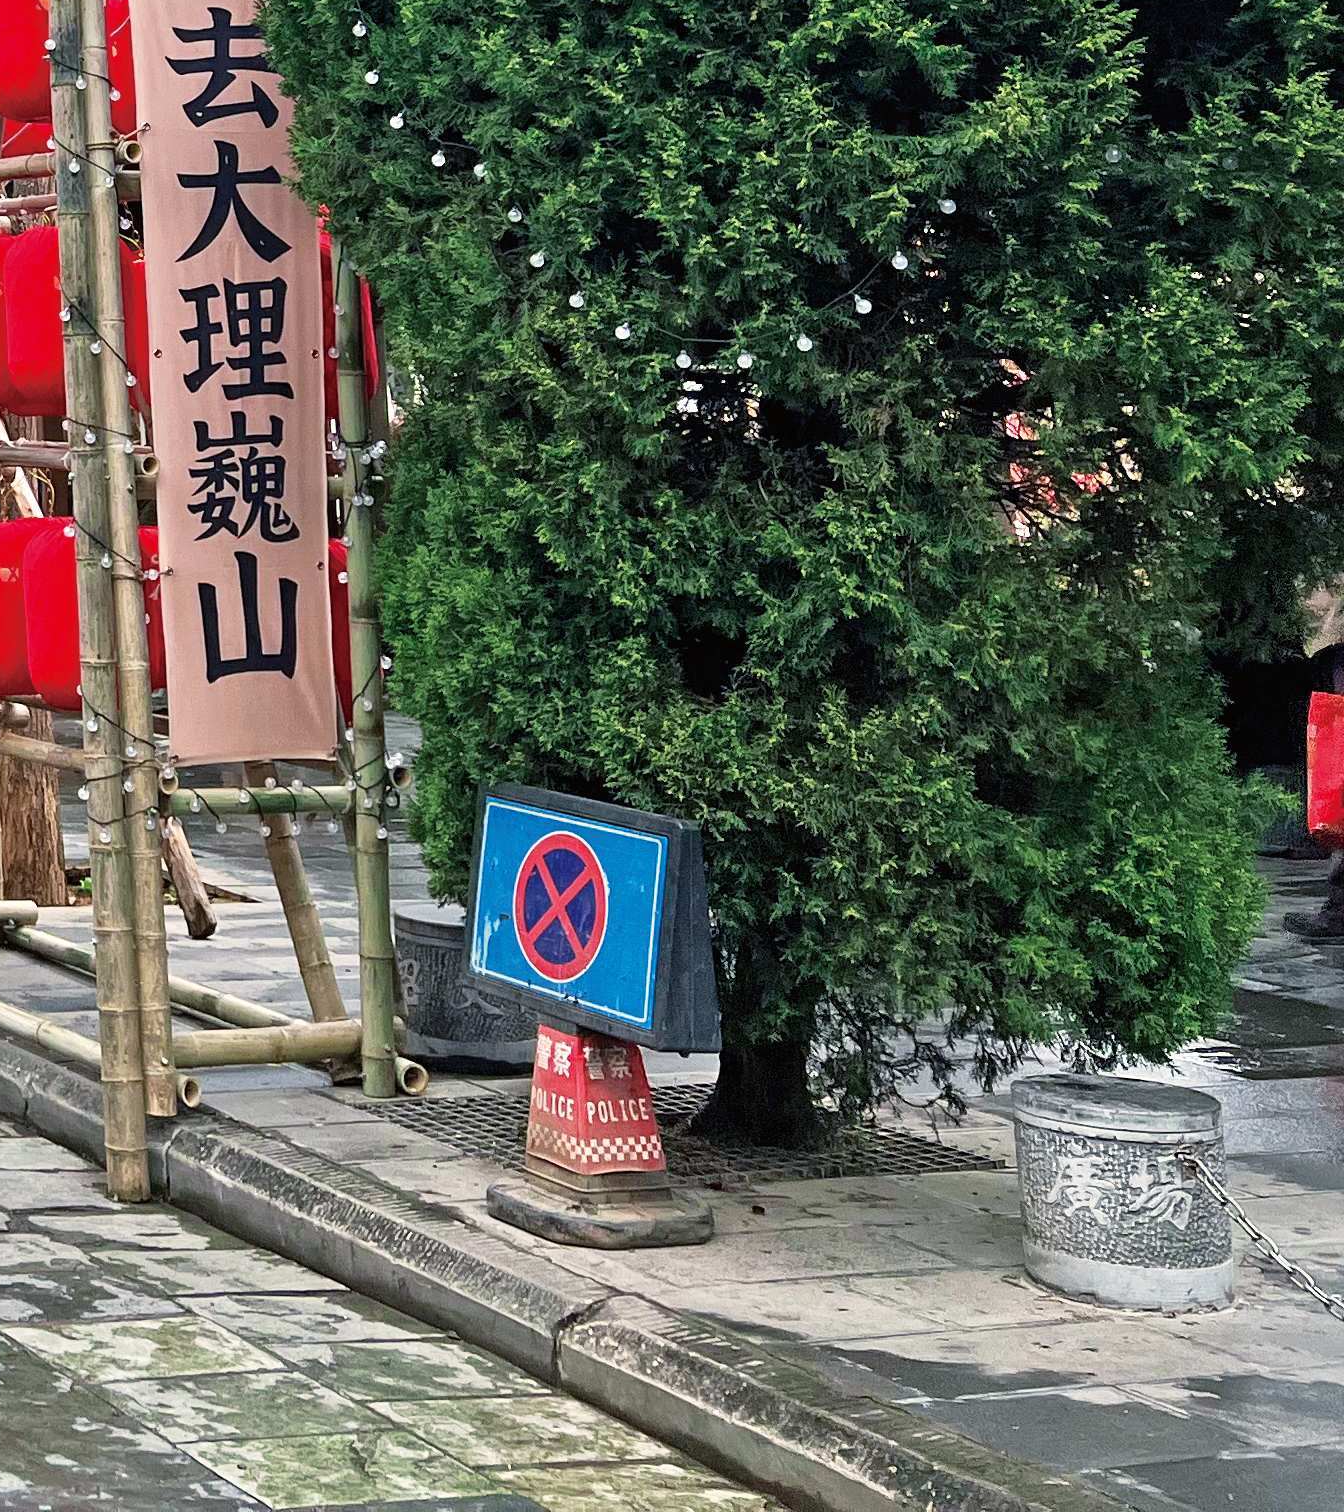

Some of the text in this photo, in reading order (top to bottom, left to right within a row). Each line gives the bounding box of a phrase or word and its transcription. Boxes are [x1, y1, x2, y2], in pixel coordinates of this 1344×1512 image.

[164, 6, 300, 684] 去大理巍山
[536, 1032, 572, 1079] 警察
[531, 1085, 574, 1121] POLICE
[586, 1098, 650, 1124] POLICE
